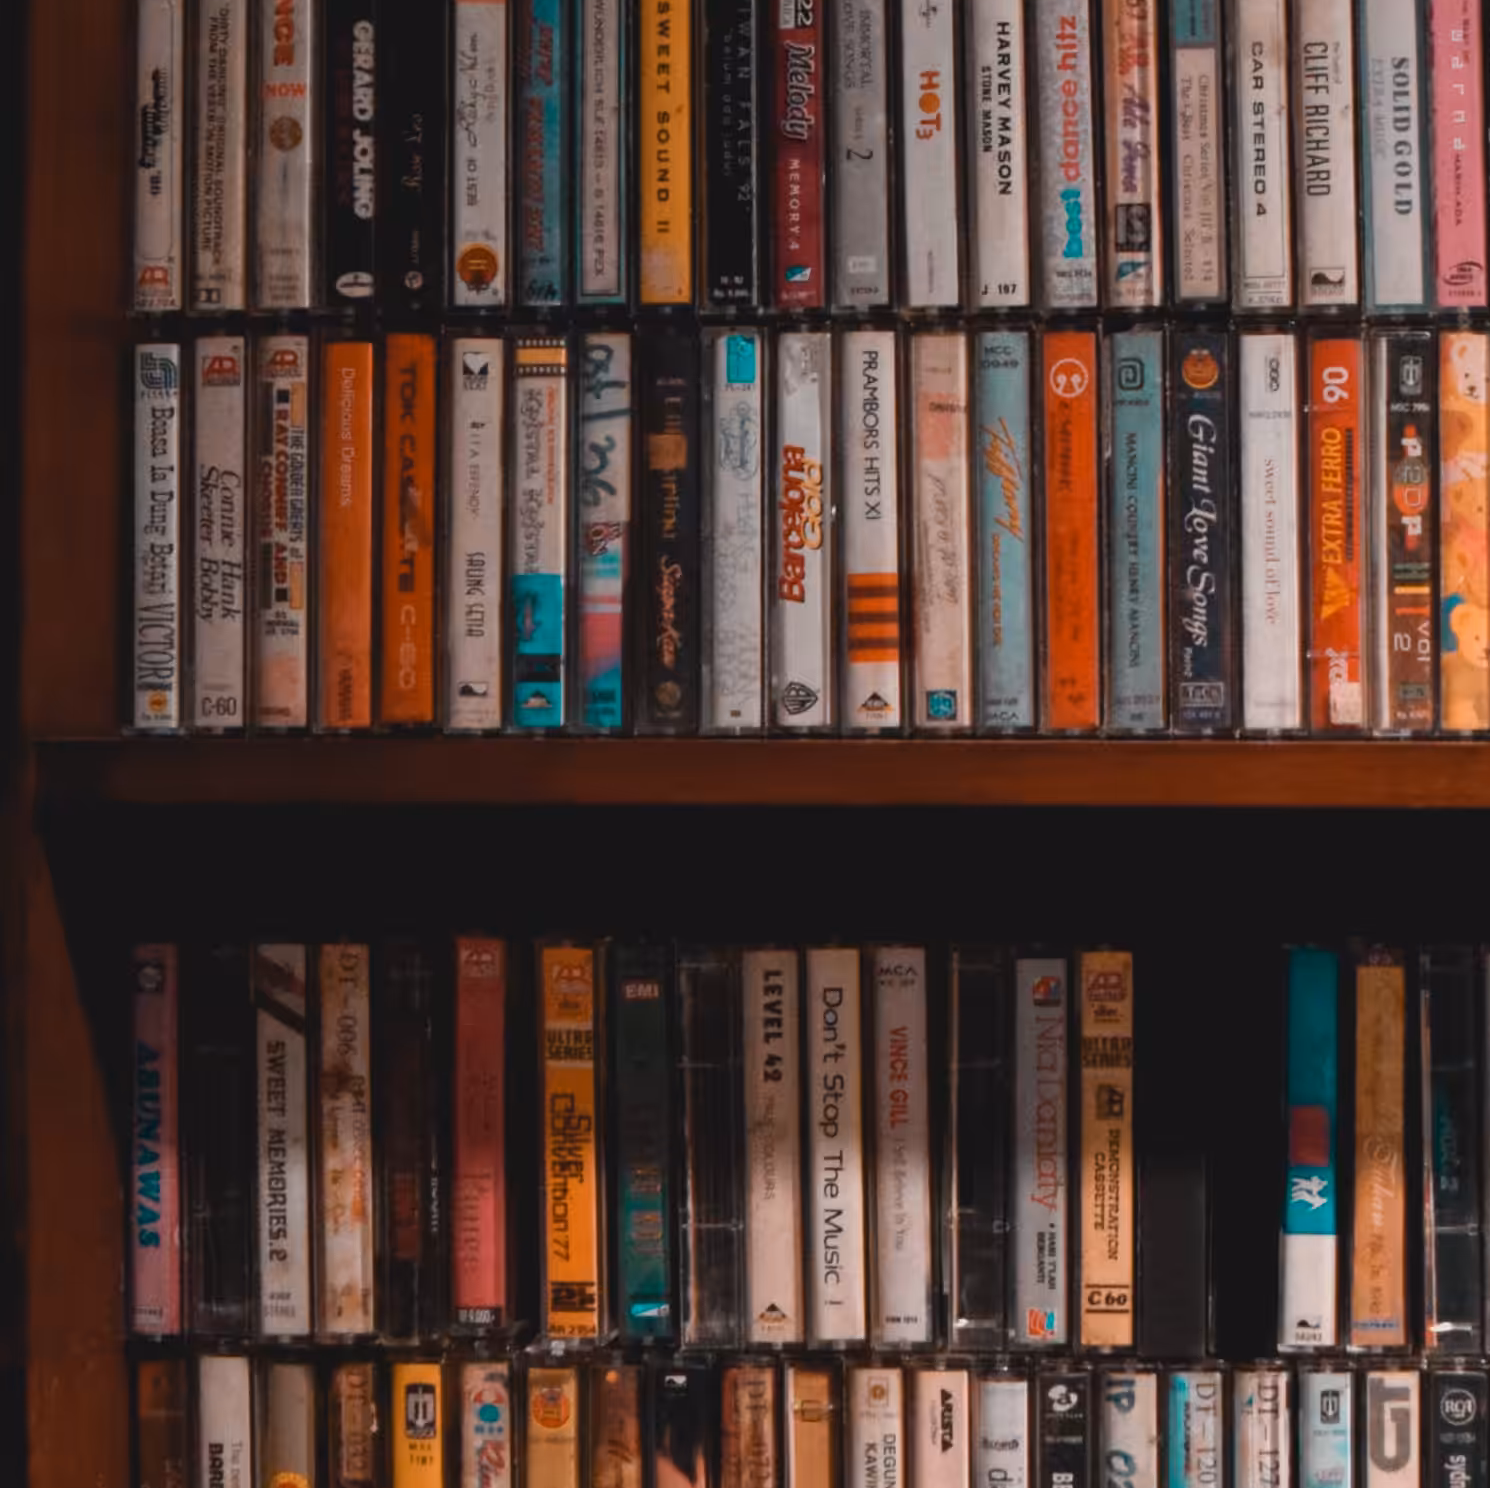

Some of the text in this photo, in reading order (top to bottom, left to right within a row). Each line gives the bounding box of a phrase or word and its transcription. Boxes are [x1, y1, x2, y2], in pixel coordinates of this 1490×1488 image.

[656, 0, 671, 94] SWEET
[781, 41, 816, 141] Melody
[997, 22, 1013, 195] HARVEY MASON
[352, 20, 376, 220] GERARD JOLING
[656, 110, 671, 203] SOUND
[1056, 15, 1083, 258] best dance hitz
[1251, 42, 1268, 217] CAR STEREO 4
[1303, 42, 1331, 197] CLIFF RICHARD
[1392, 57, 1412, 216] SOLID GOLD
[340, 368, 357, 507] Delicious Dreams
[863, 350, 881, 521] PRAMBORS HITS XI
[199, 464, 220, 624] Skeeter Bobby
[220, 470, 242, 621] Connie Hank
[780, 444, 806, 603] Barcelona
[1182, 414, 1217, 649] Giant Love Songs
[267, 1040, 287, 1118] SWEET
[763, 969, 784, 1084] LEVEL 42
[823, 986, 846, 1064] Don't
[889, 1026, 911, 1130] VINCE GILL
[138, 1040, 161, 1249] ABUNAWAS
[819, 1073, 844, 1138] Stop
[823, 1149, 844, 1199] The
[823, 1208, 844, 1286] Music
[1093, 1151, 1108, 1232] CASSETTE
[1107, 1128, 1121, 1262] DEMONSTRATION
